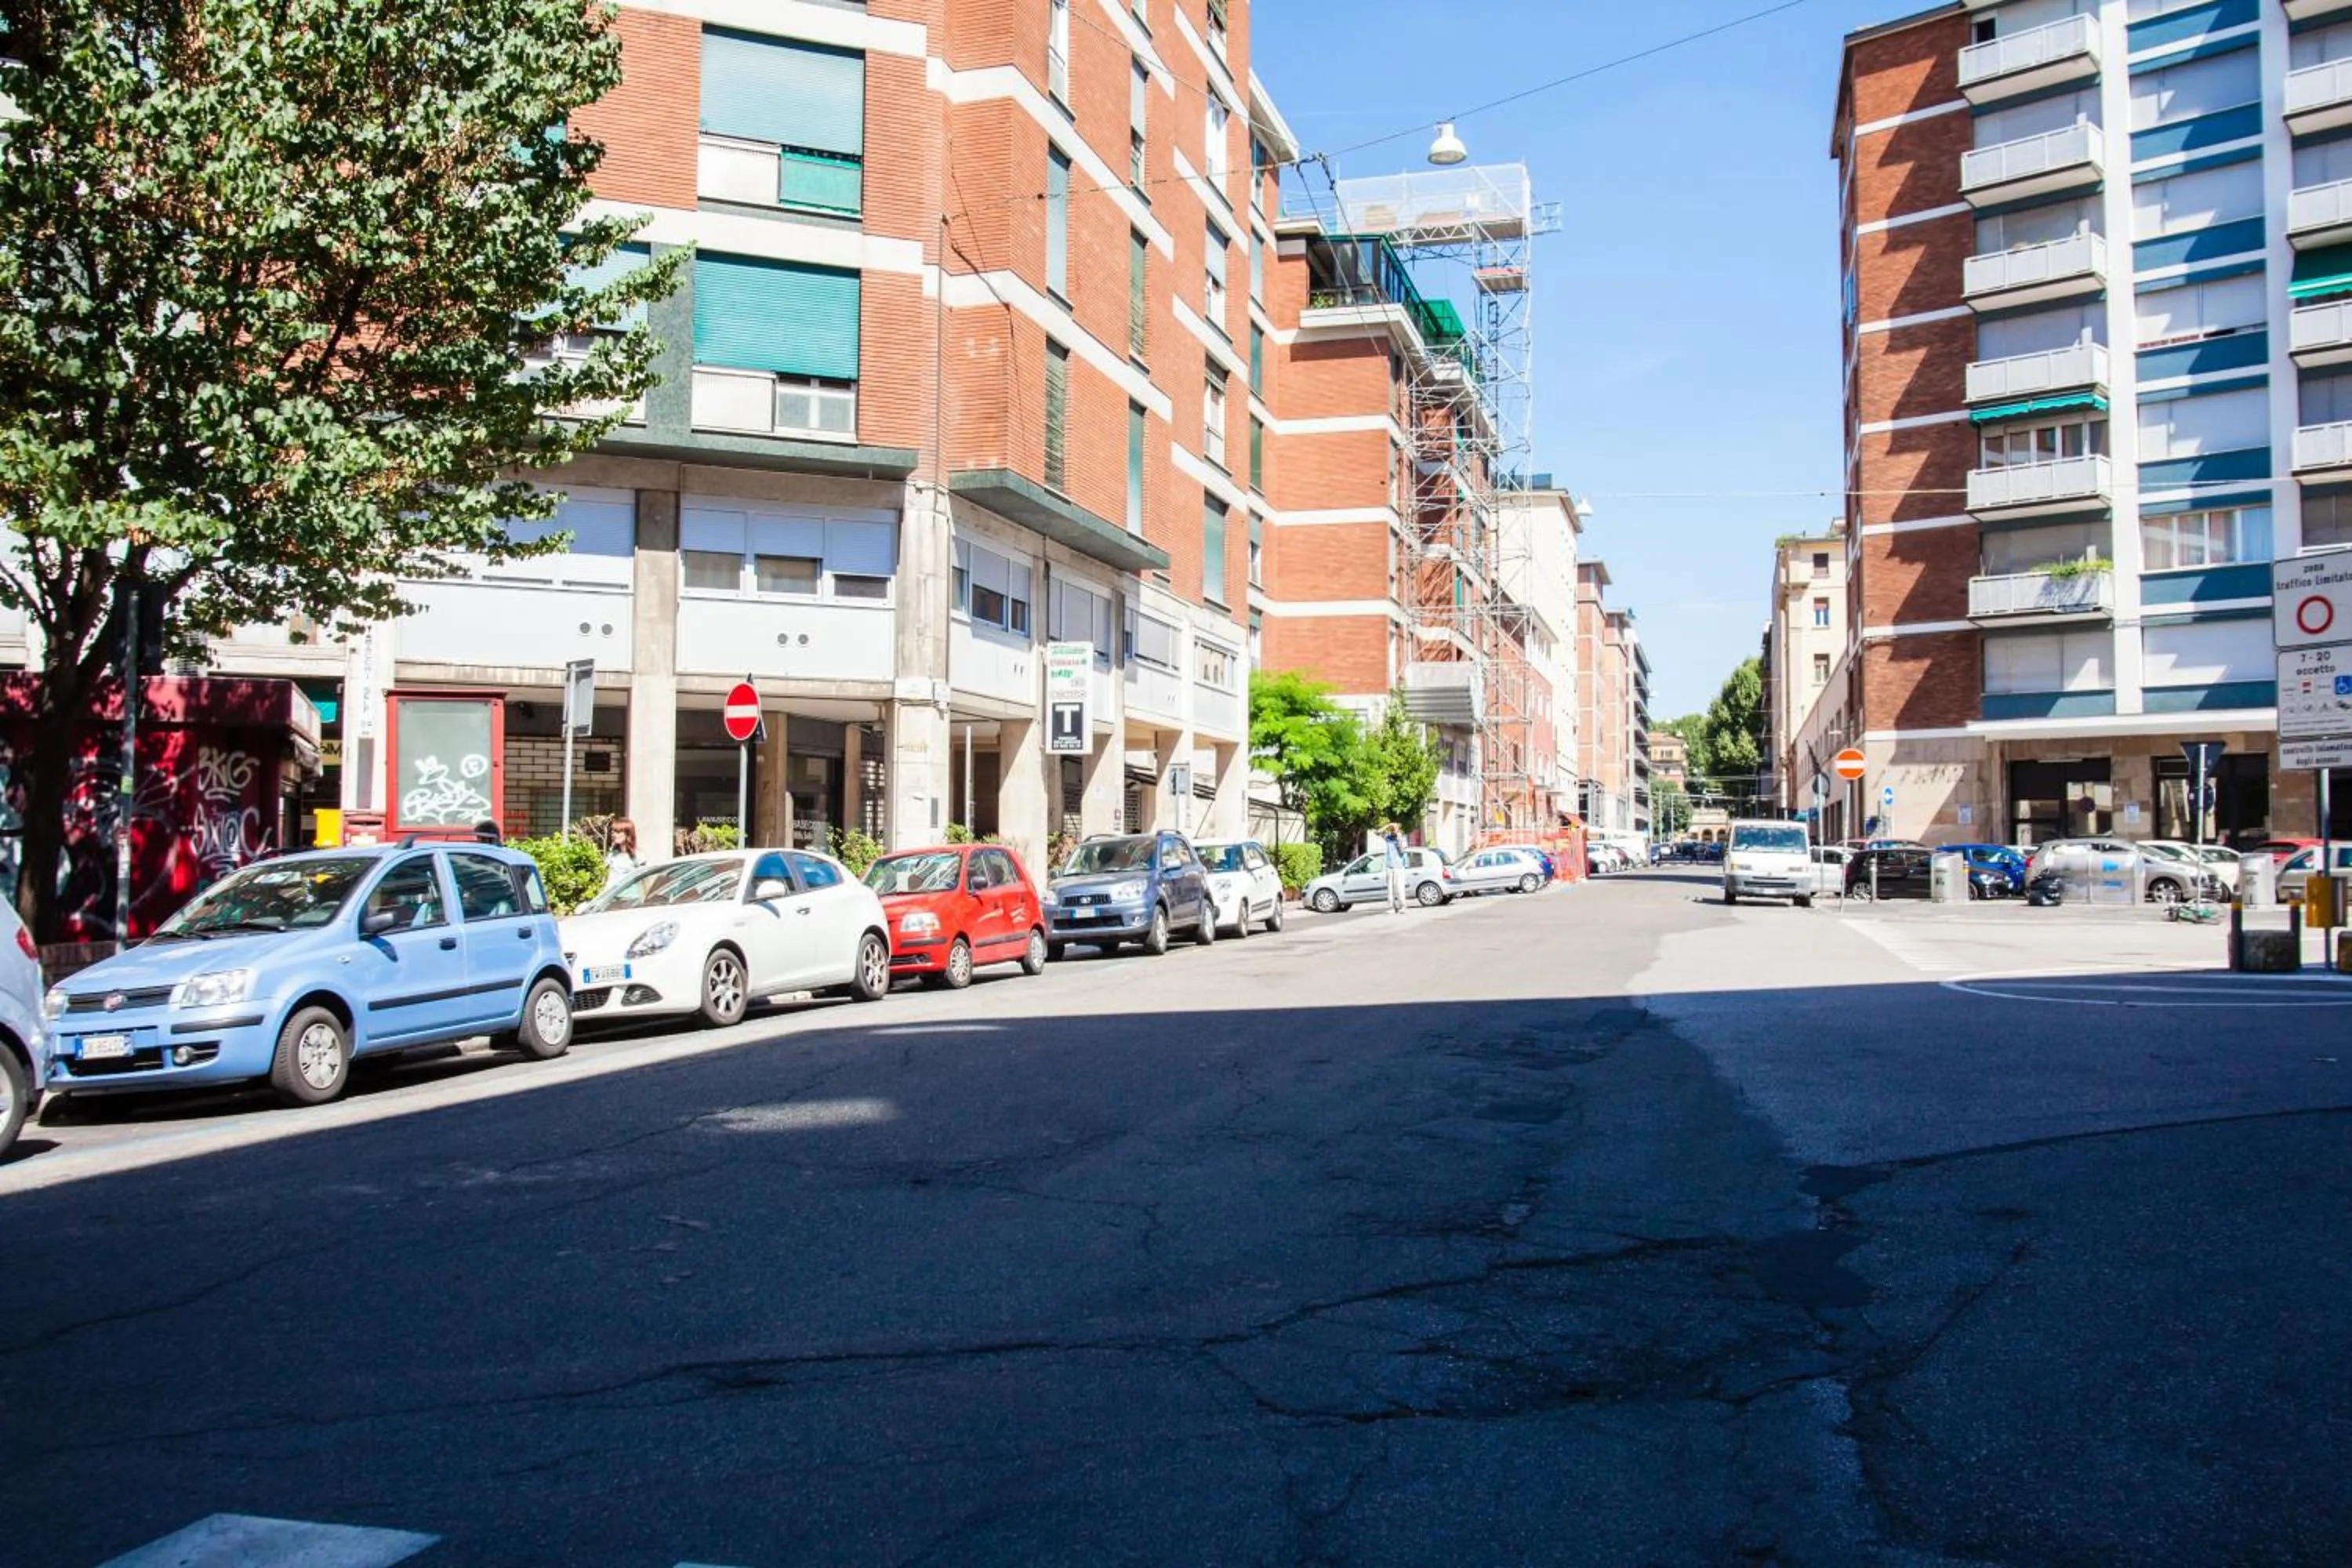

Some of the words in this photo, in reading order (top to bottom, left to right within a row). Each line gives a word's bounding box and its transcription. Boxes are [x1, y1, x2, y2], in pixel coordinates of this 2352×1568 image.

[2303, 563, 2325, 573] zona
[2276, 578, 2312, 590] traffico
[2317, 651, 2331, 662] 20
[2296, 665, 2336, 676] eccetto
[1054, 705, 1080, 733] T
